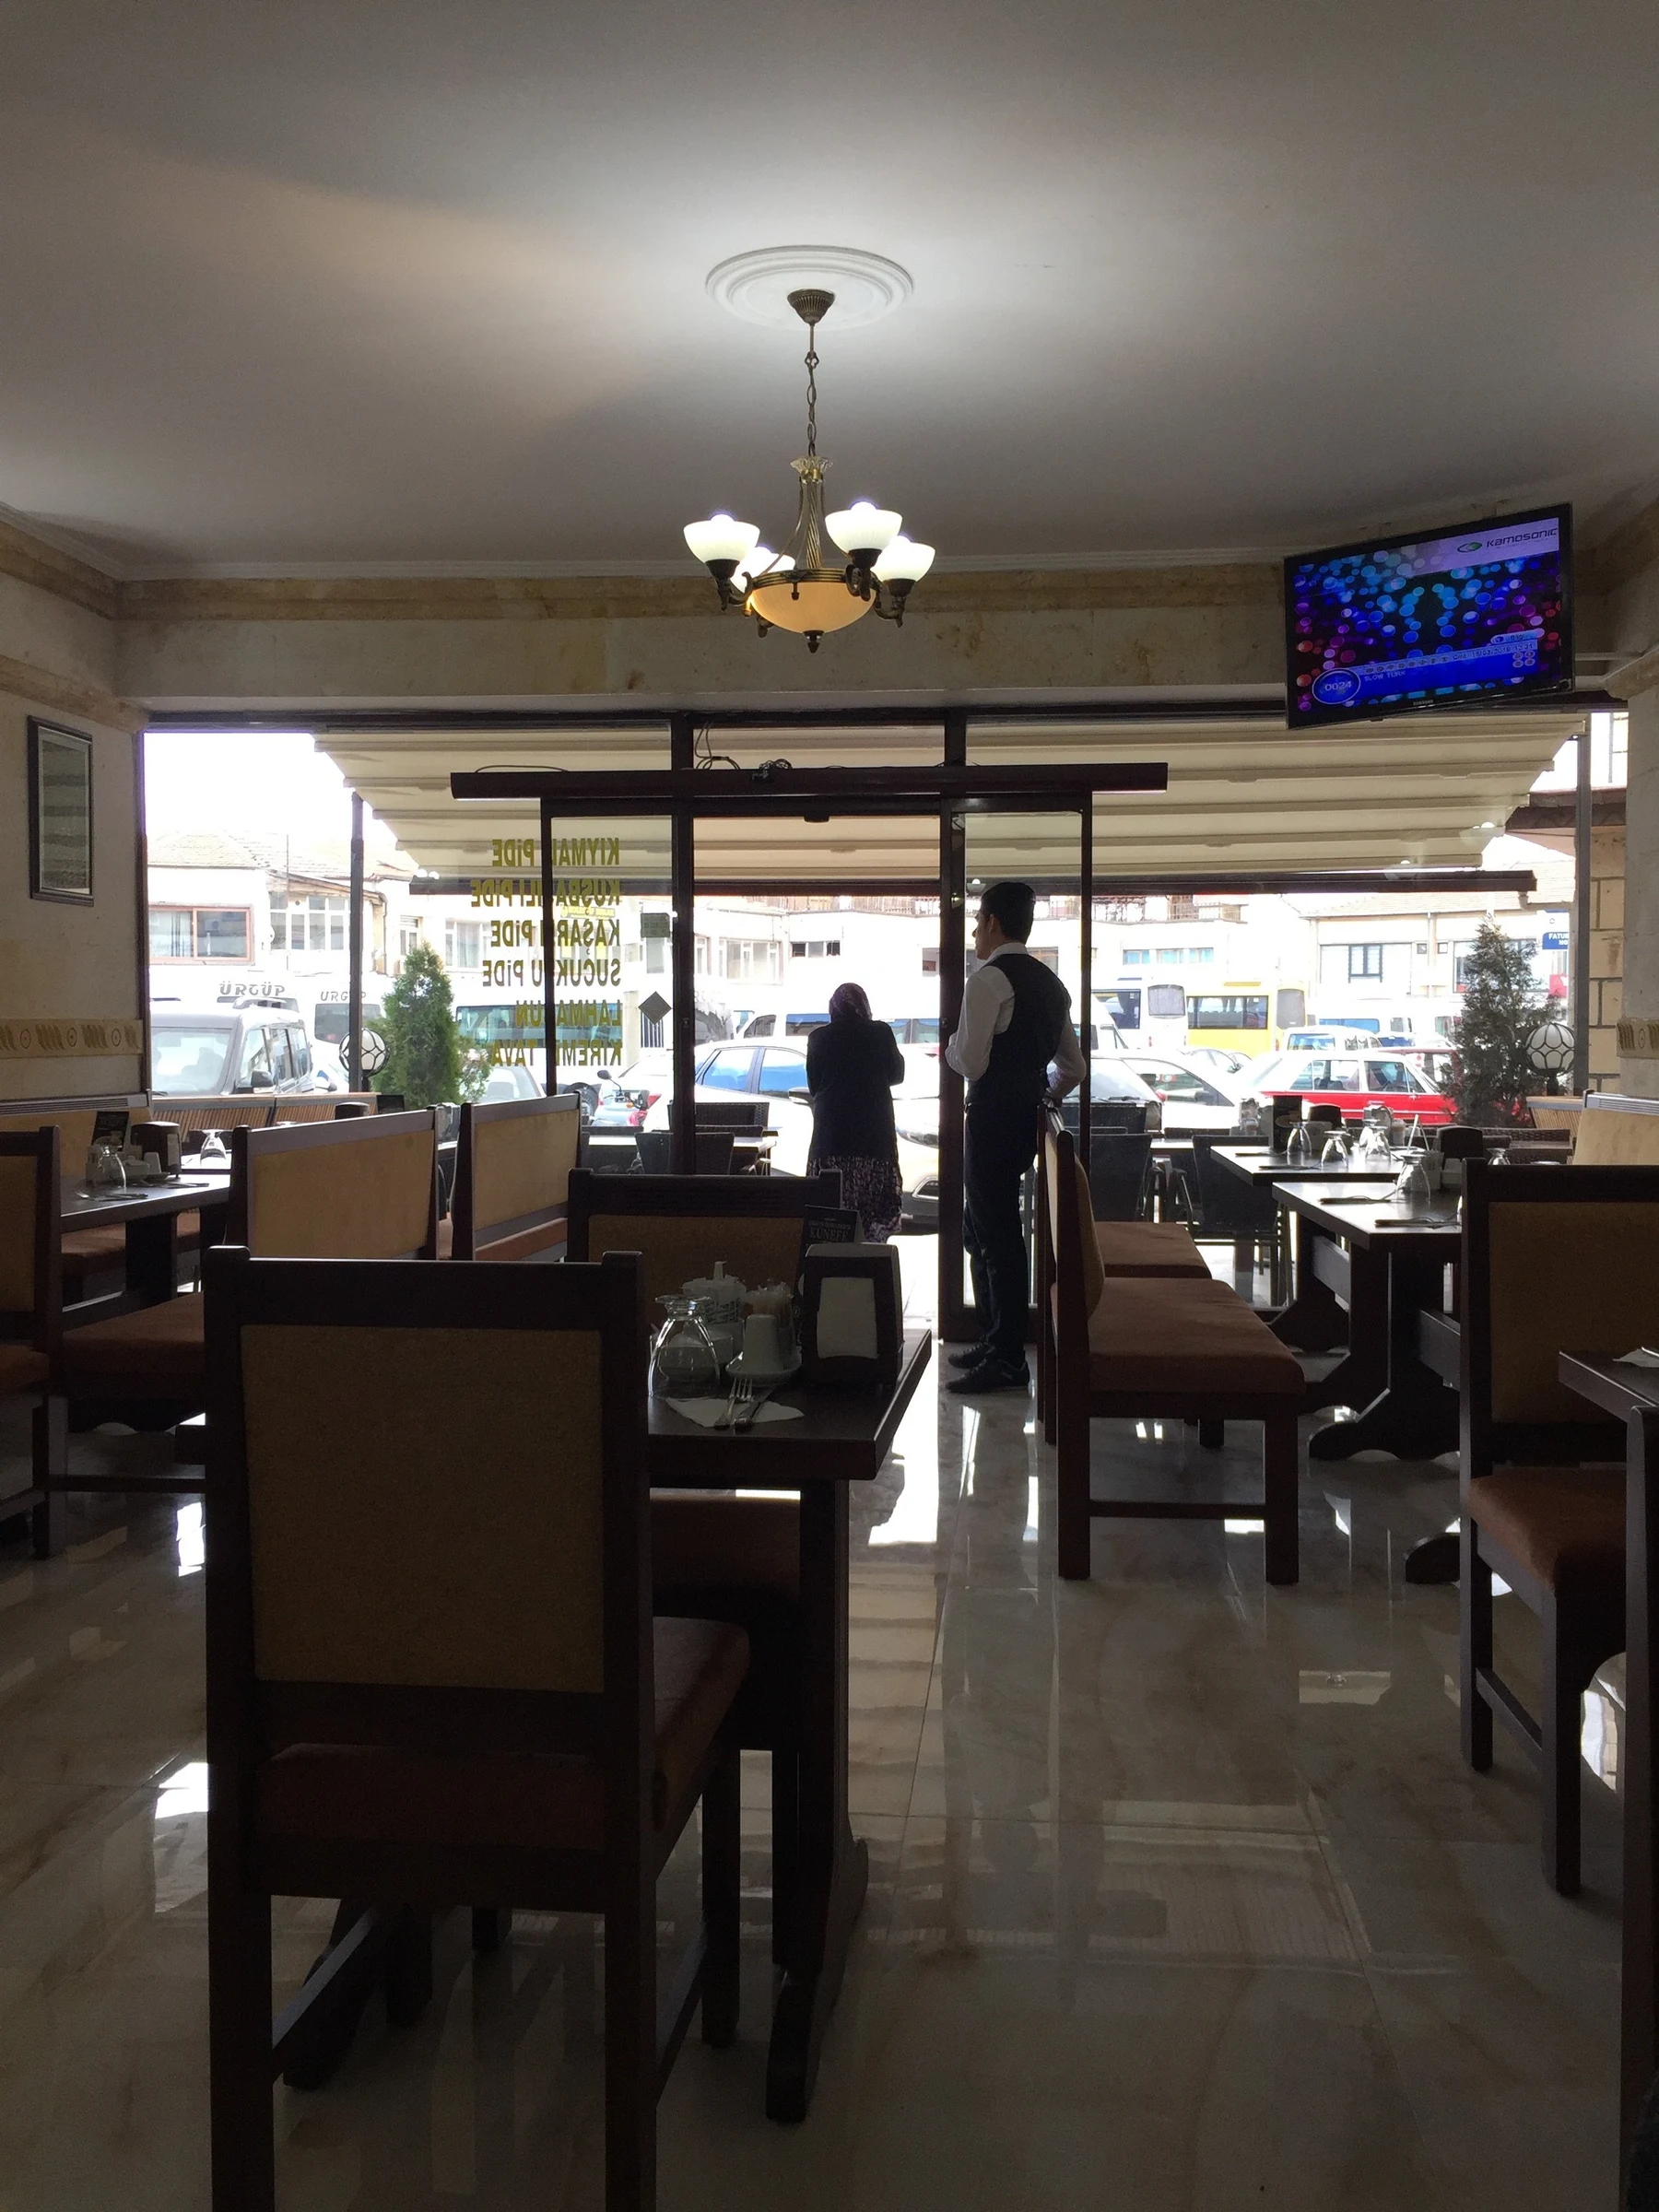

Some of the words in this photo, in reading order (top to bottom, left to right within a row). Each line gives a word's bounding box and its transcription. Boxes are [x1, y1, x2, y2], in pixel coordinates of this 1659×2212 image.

[1364, 673, 1384, 682] SLOW
[1324, 680, 1352, 691] 0024
[320, 991, 367, 1002] URGP
